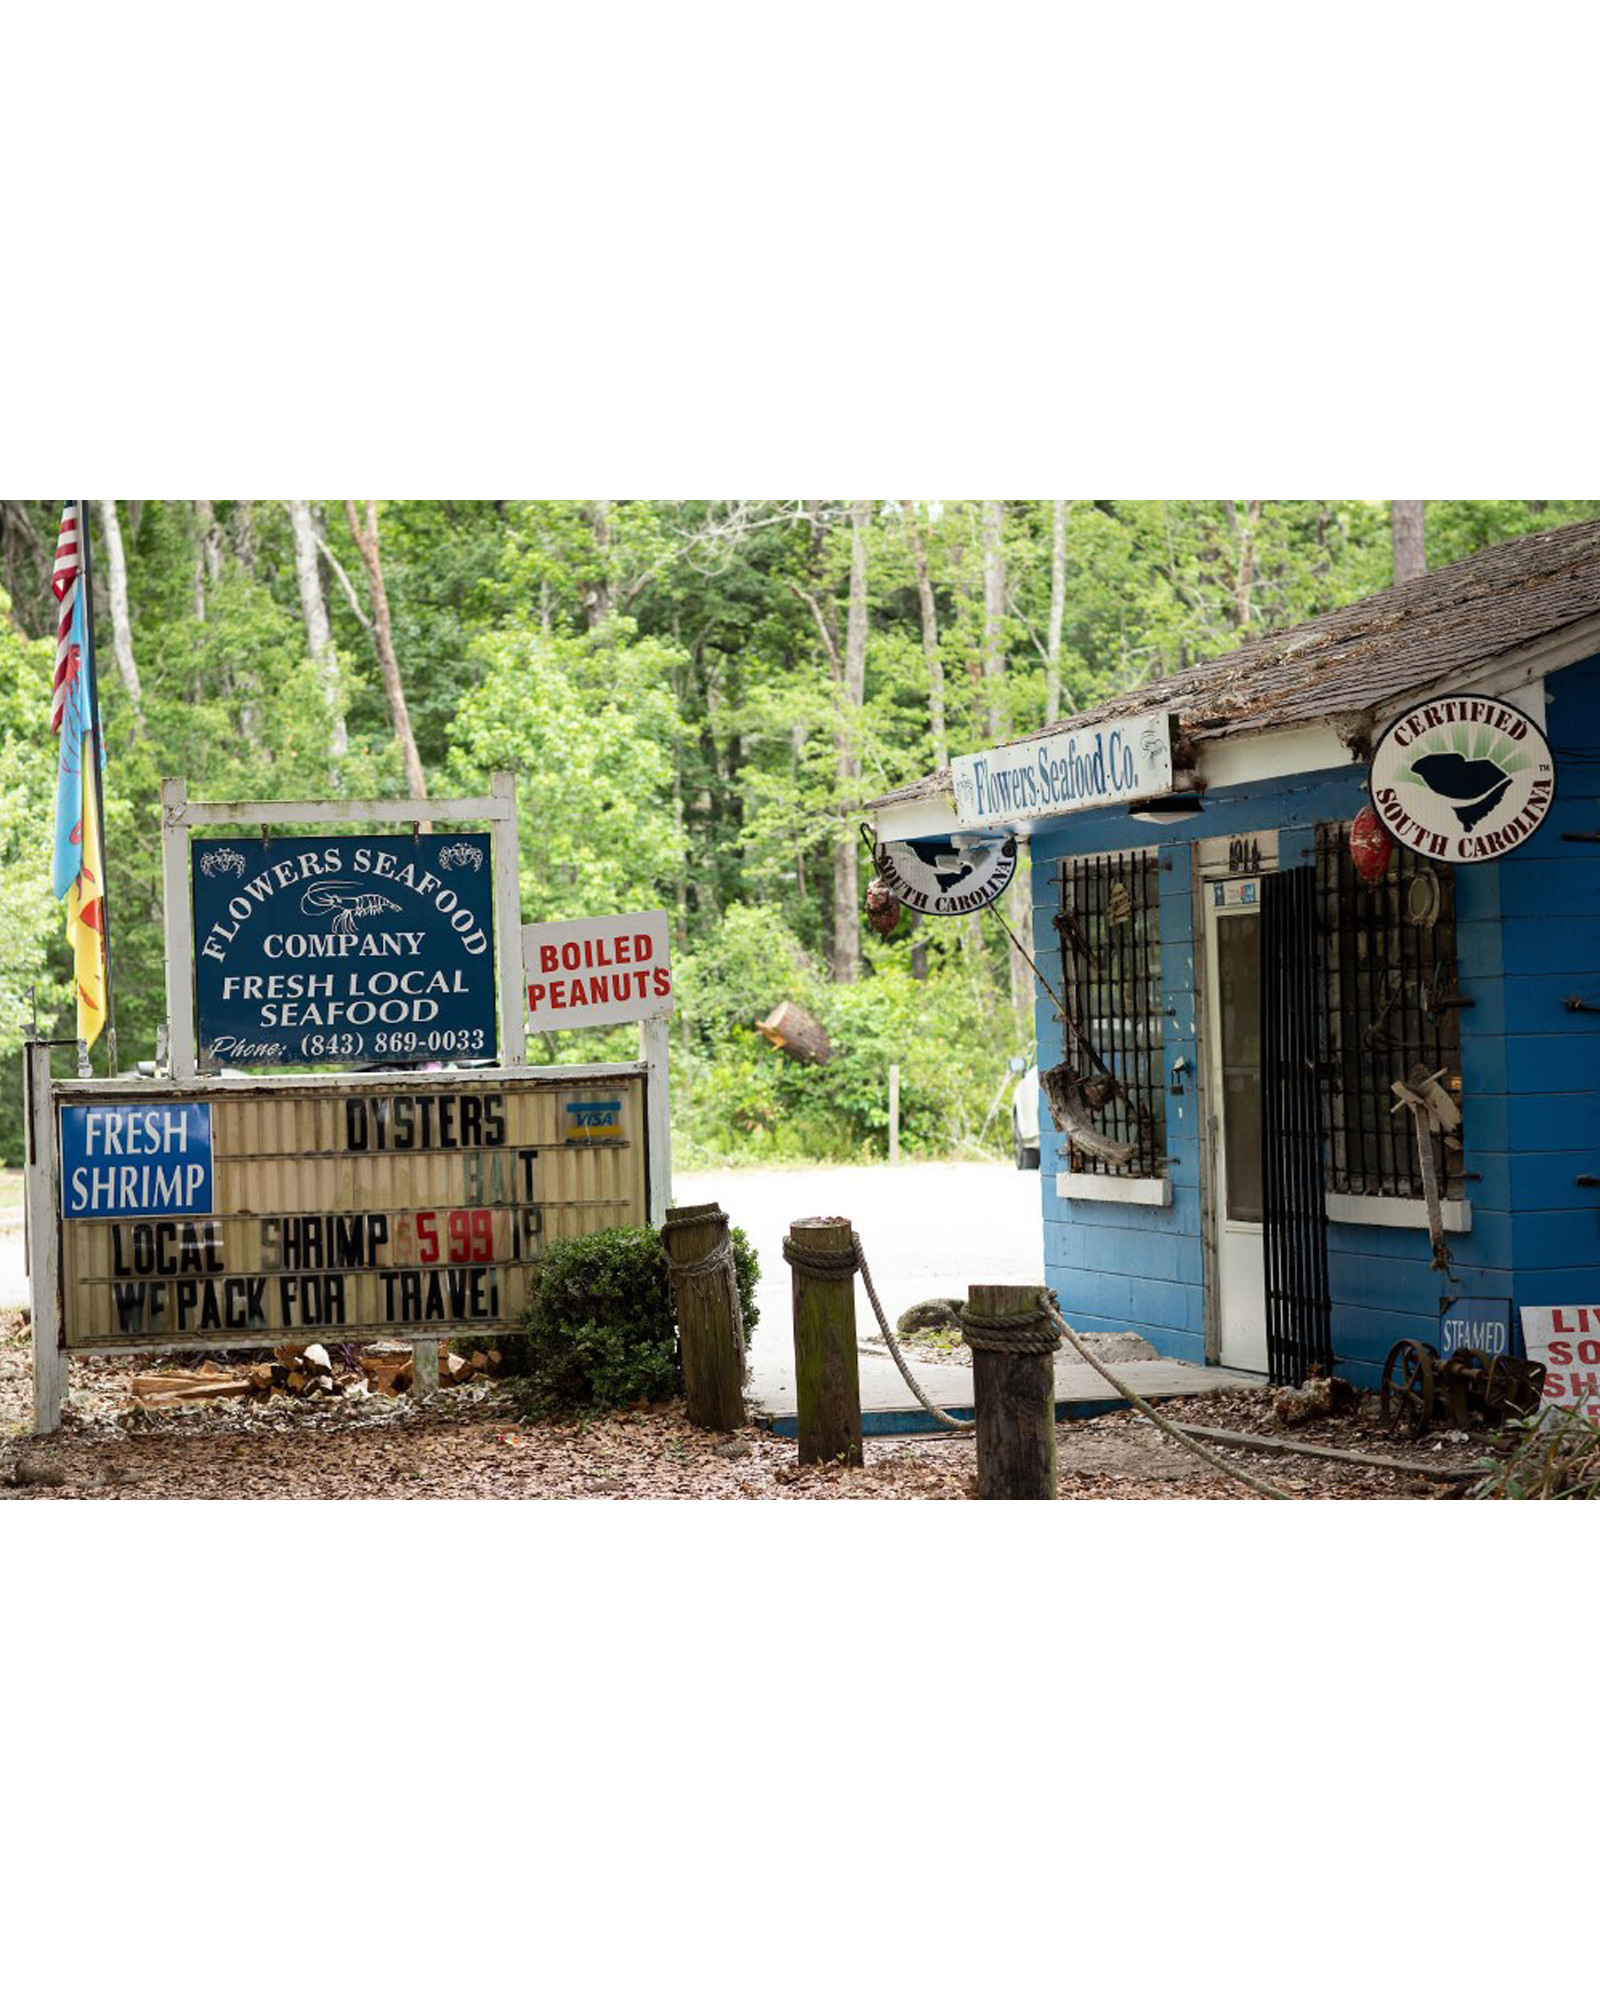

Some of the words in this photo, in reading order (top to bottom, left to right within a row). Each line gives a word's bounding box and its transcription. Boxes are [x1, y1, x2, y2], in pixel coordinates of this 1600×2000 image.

[1393, 701, 1528, 747] CERTIFIED
[973, 758, 1036, 815] Flowers
[1038, 733, 1106, 804] Seafood
[1109, 730, 1139, 792] Co.
[1376, 788, 1449, 857] SOUTH
[1458, 779, 1552, 858] CAROLINA
[202, 848, 341, 963] FLOWERS
[353, 848, 487, 955] SEAFOOD
[935, 861, 1012, 912] CAROLINA
[263, 932, 425, 958] COMPANY
[540, 934, 653, 973] BOILED
[222, 974, 334, 1000] FRESH
[349, 969, 469, 996] LOCAL
[527, 967, 671, 1012] PEANUTS
[260, 999, 439, 1027] SEAFOOD
[209, 1036, 287, 1059] Phone:
[301, 1032, 364, 1056] (843)
[375, 1029, 484, 1053] 869-0033
[85, 1111, 187, 1156] FRESH
[346, 1094, 505, 1150] OYSTERS
[576, 1113, 613, 1127] VISA
[71, 1163, 204, 1211] SHRIMP
[112, 1221, 224, 1276] LOCAL
[261, 1214, 387, 1271] SHRIMP
[177, 1277, 267, 1330] PACK
[279, 1274, 345, 1326] FOR
[1443, 1320, 1505, 1354] STEAMED
